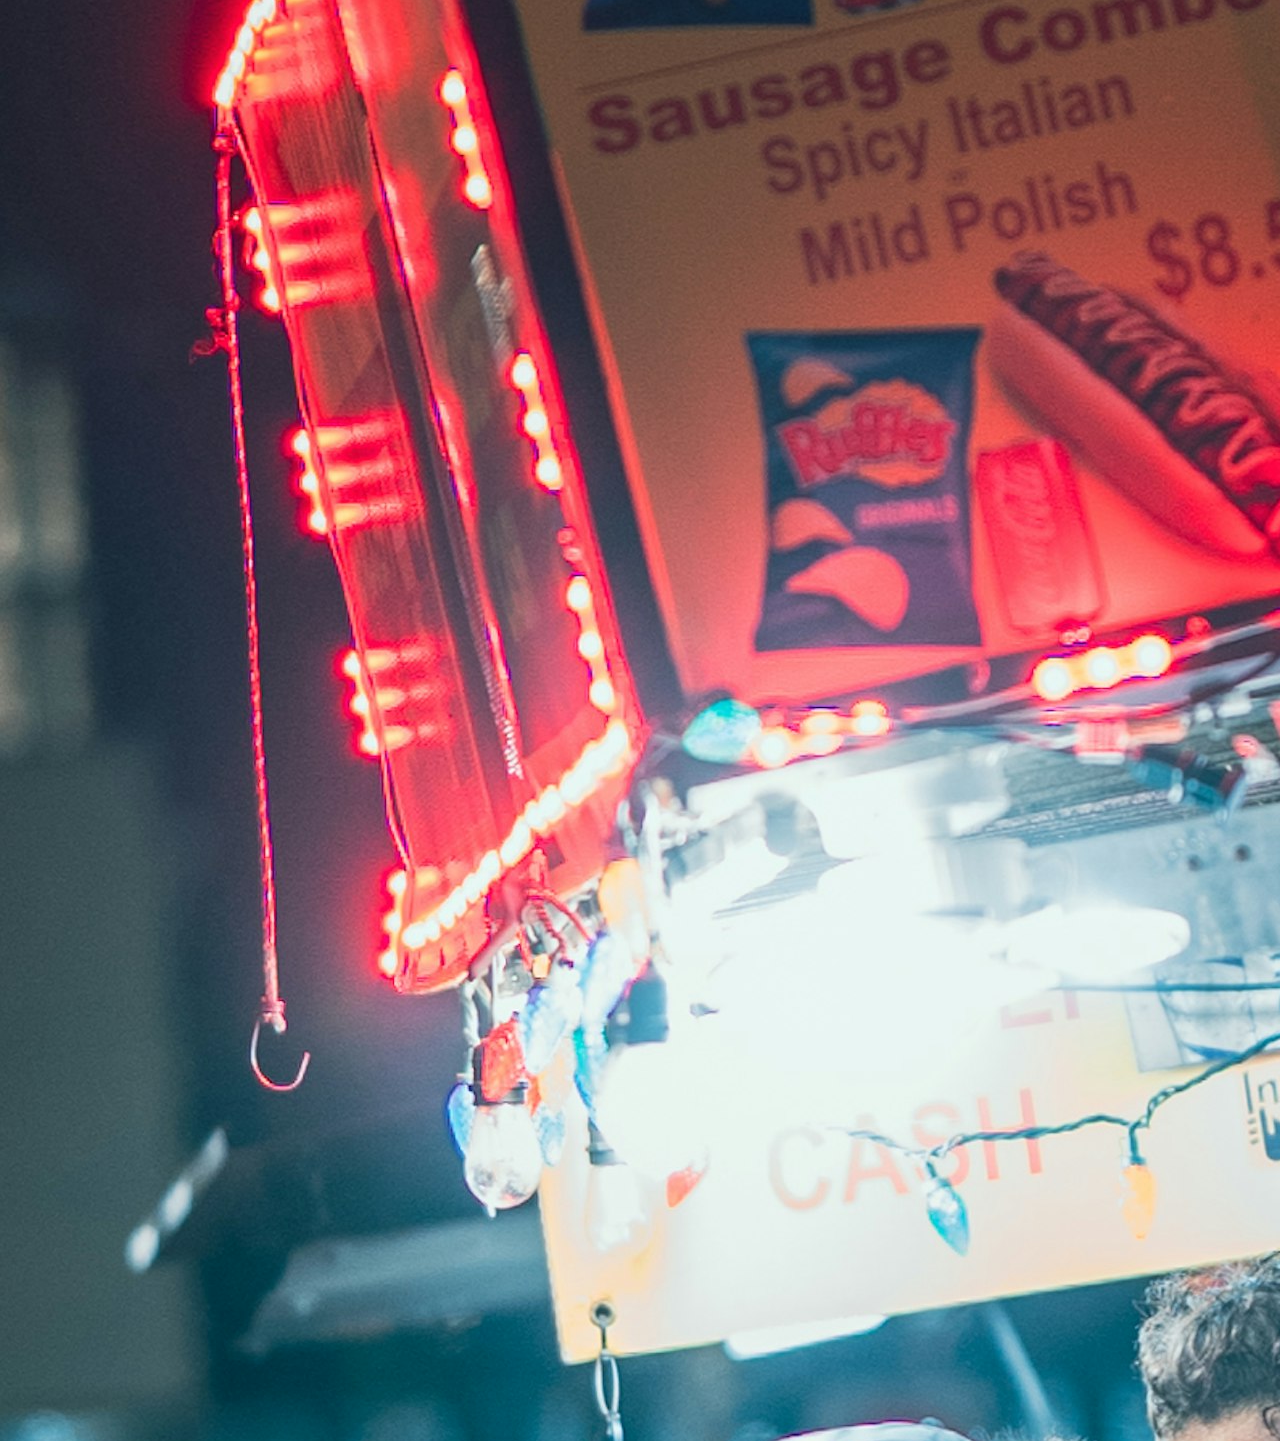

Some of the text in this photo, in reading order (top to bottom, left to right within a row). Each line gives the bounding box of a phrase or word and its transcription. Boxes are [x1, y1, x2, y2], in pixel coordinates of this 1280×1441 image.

[587, 37, 952, 155] Sausage
[762, 72, 1137, 200] Spicy Italian
[802, 163, 1140, 286] Mild Polish
[782, 402, 956, 485] Ruffles
[770, 1089, 1046, 1213] CASH
